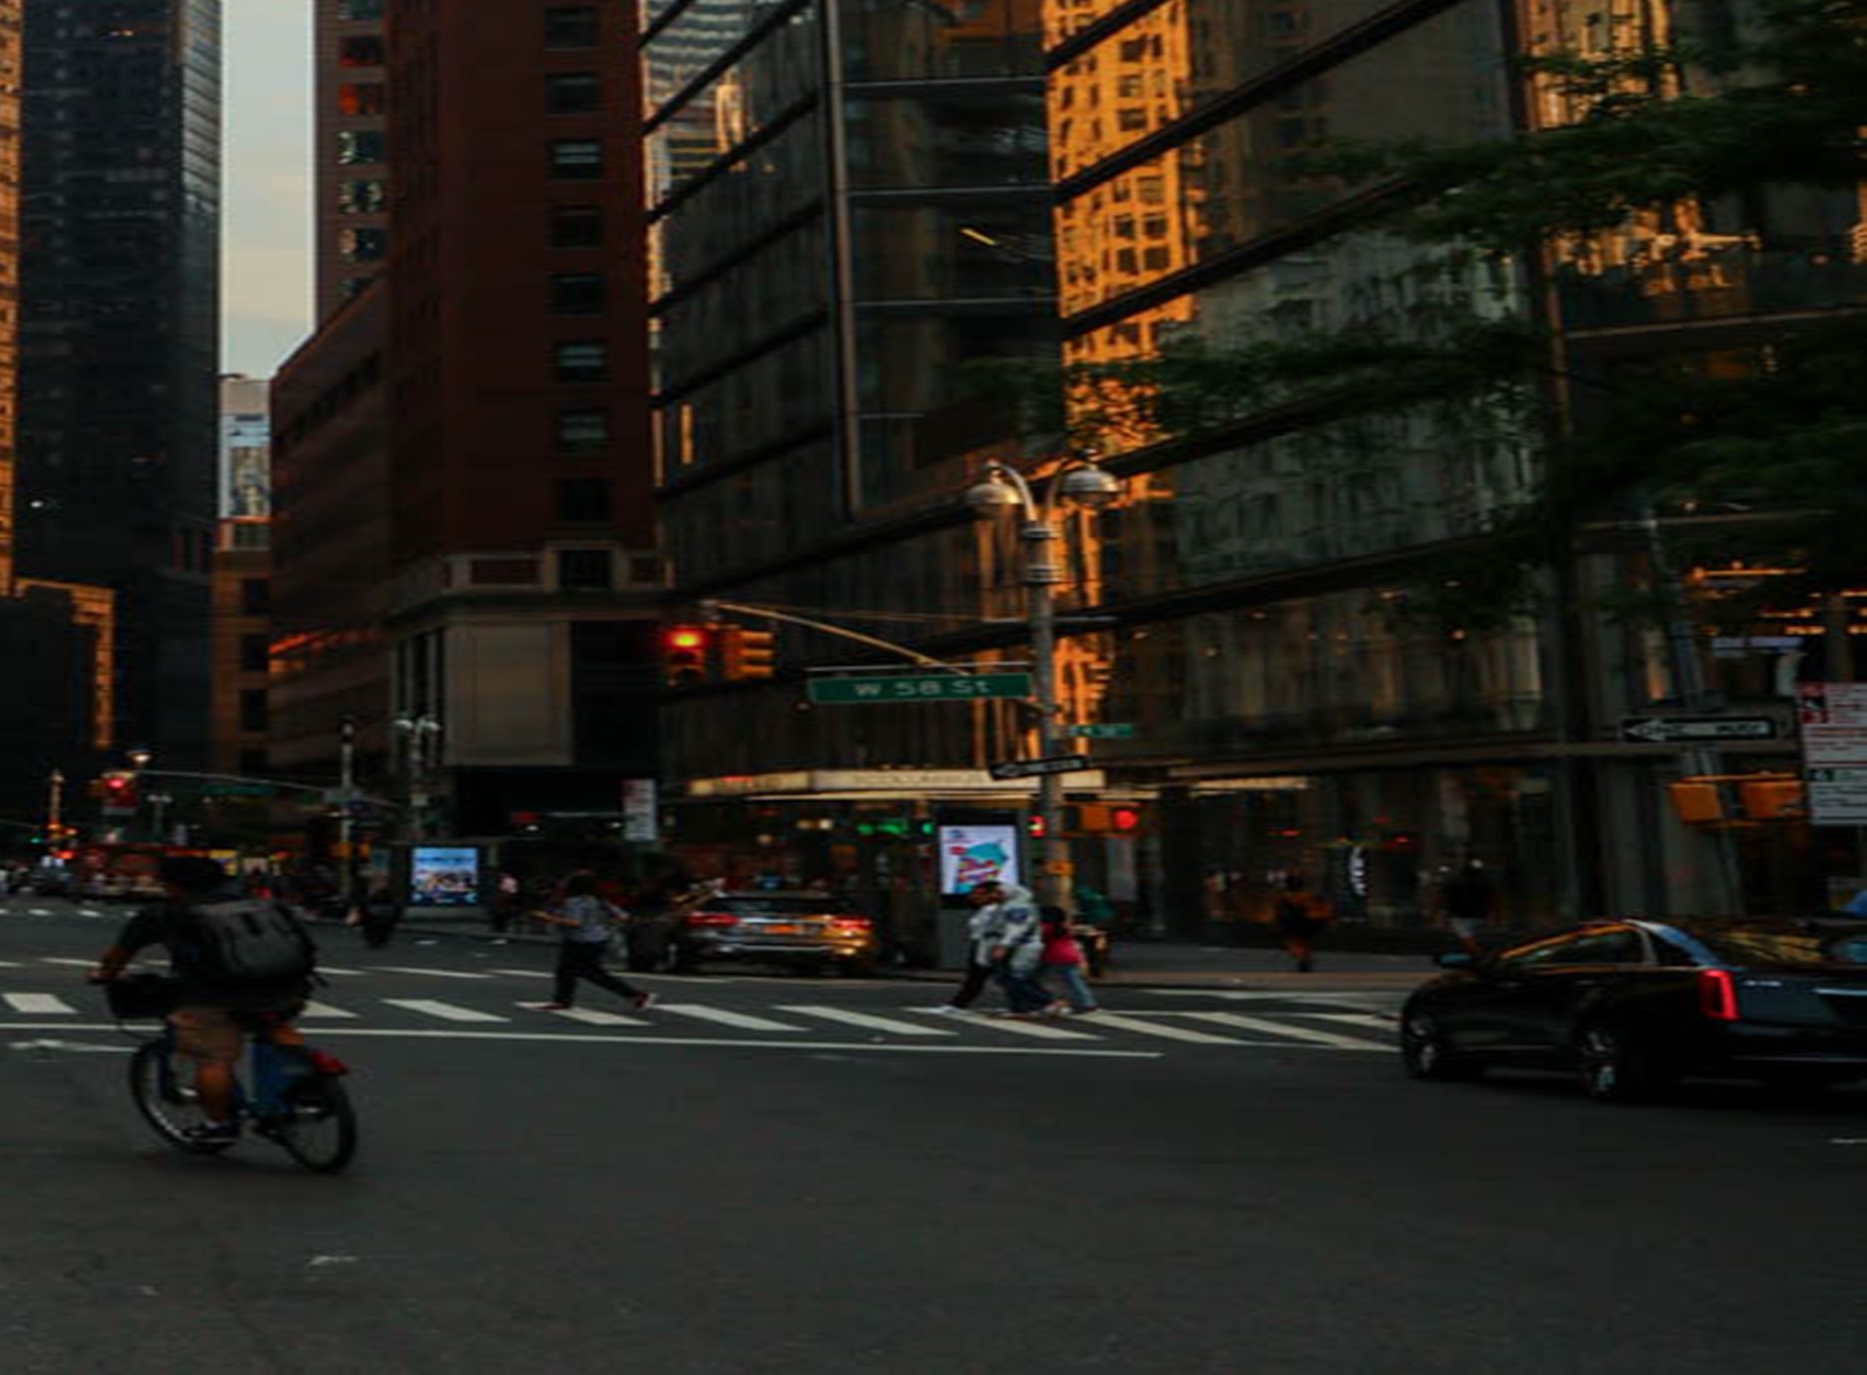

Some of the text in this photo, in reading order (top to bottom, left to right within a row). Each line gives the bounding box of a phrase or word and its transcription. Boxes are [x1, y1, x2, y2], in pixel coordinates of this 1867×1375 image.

[854, 679, 990, 697] W 58 St
